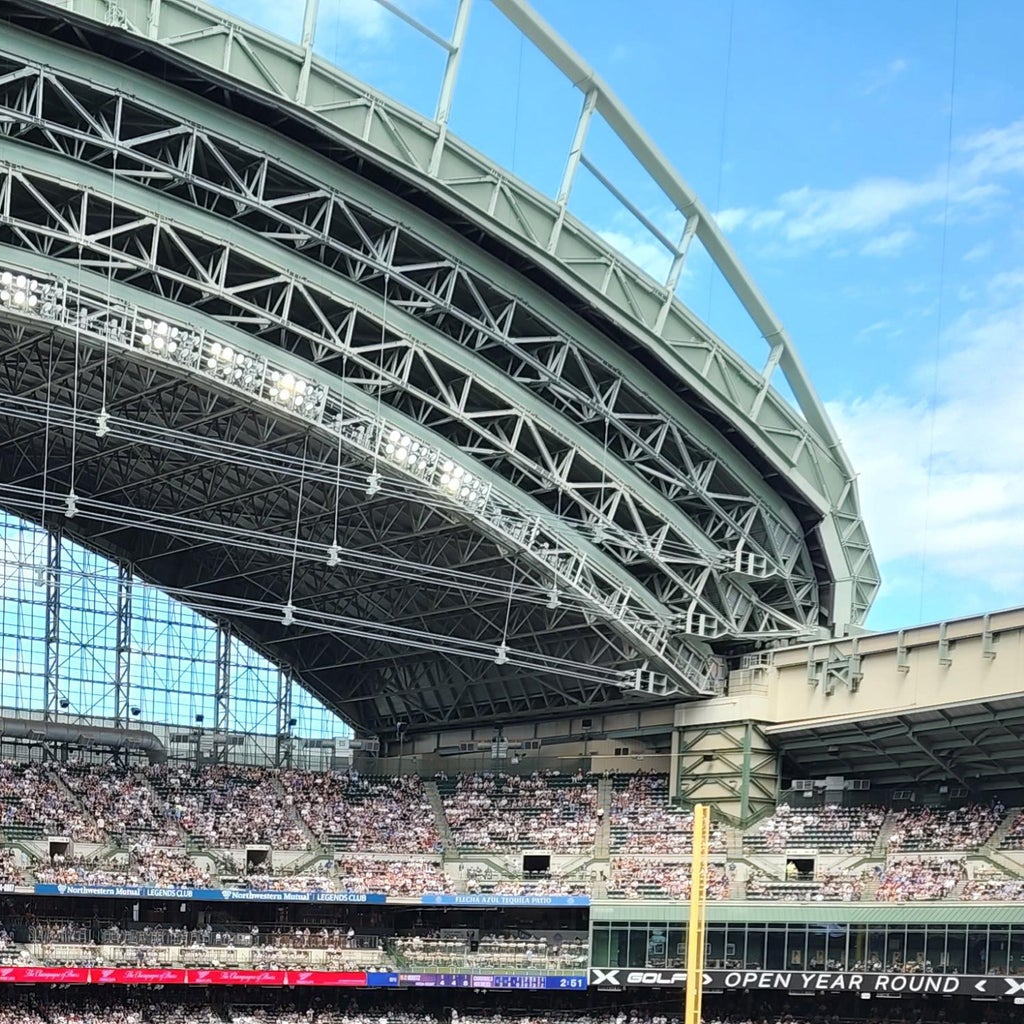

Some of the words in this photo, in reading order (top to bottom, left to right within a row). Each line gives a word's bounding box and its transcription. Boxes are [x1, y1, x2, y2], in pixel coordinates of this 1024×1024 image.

[67, 886, 114, 895] Northwestern
[116, 887, 140, 896] Mutual
[147, 888, 175, 897] LEGENDS
[176, 889, 193, 898] CLUB
[232, 890, 283, 900] Northwestern
[284, 891, 310, 901] Mutual
[317, 893, 348, 902] LEGENDS
[349, 894, 367, 902] CLUB
[481, 896, 500, 904] AZUL
[627, 972, 687, 984] GOLF
[725, 972, 791, 988] OPEN
[801, 974, 863, 990] YEAR
[875, 975, 959, 993] ROUND
[559, 979, 582, 988] 2:51
